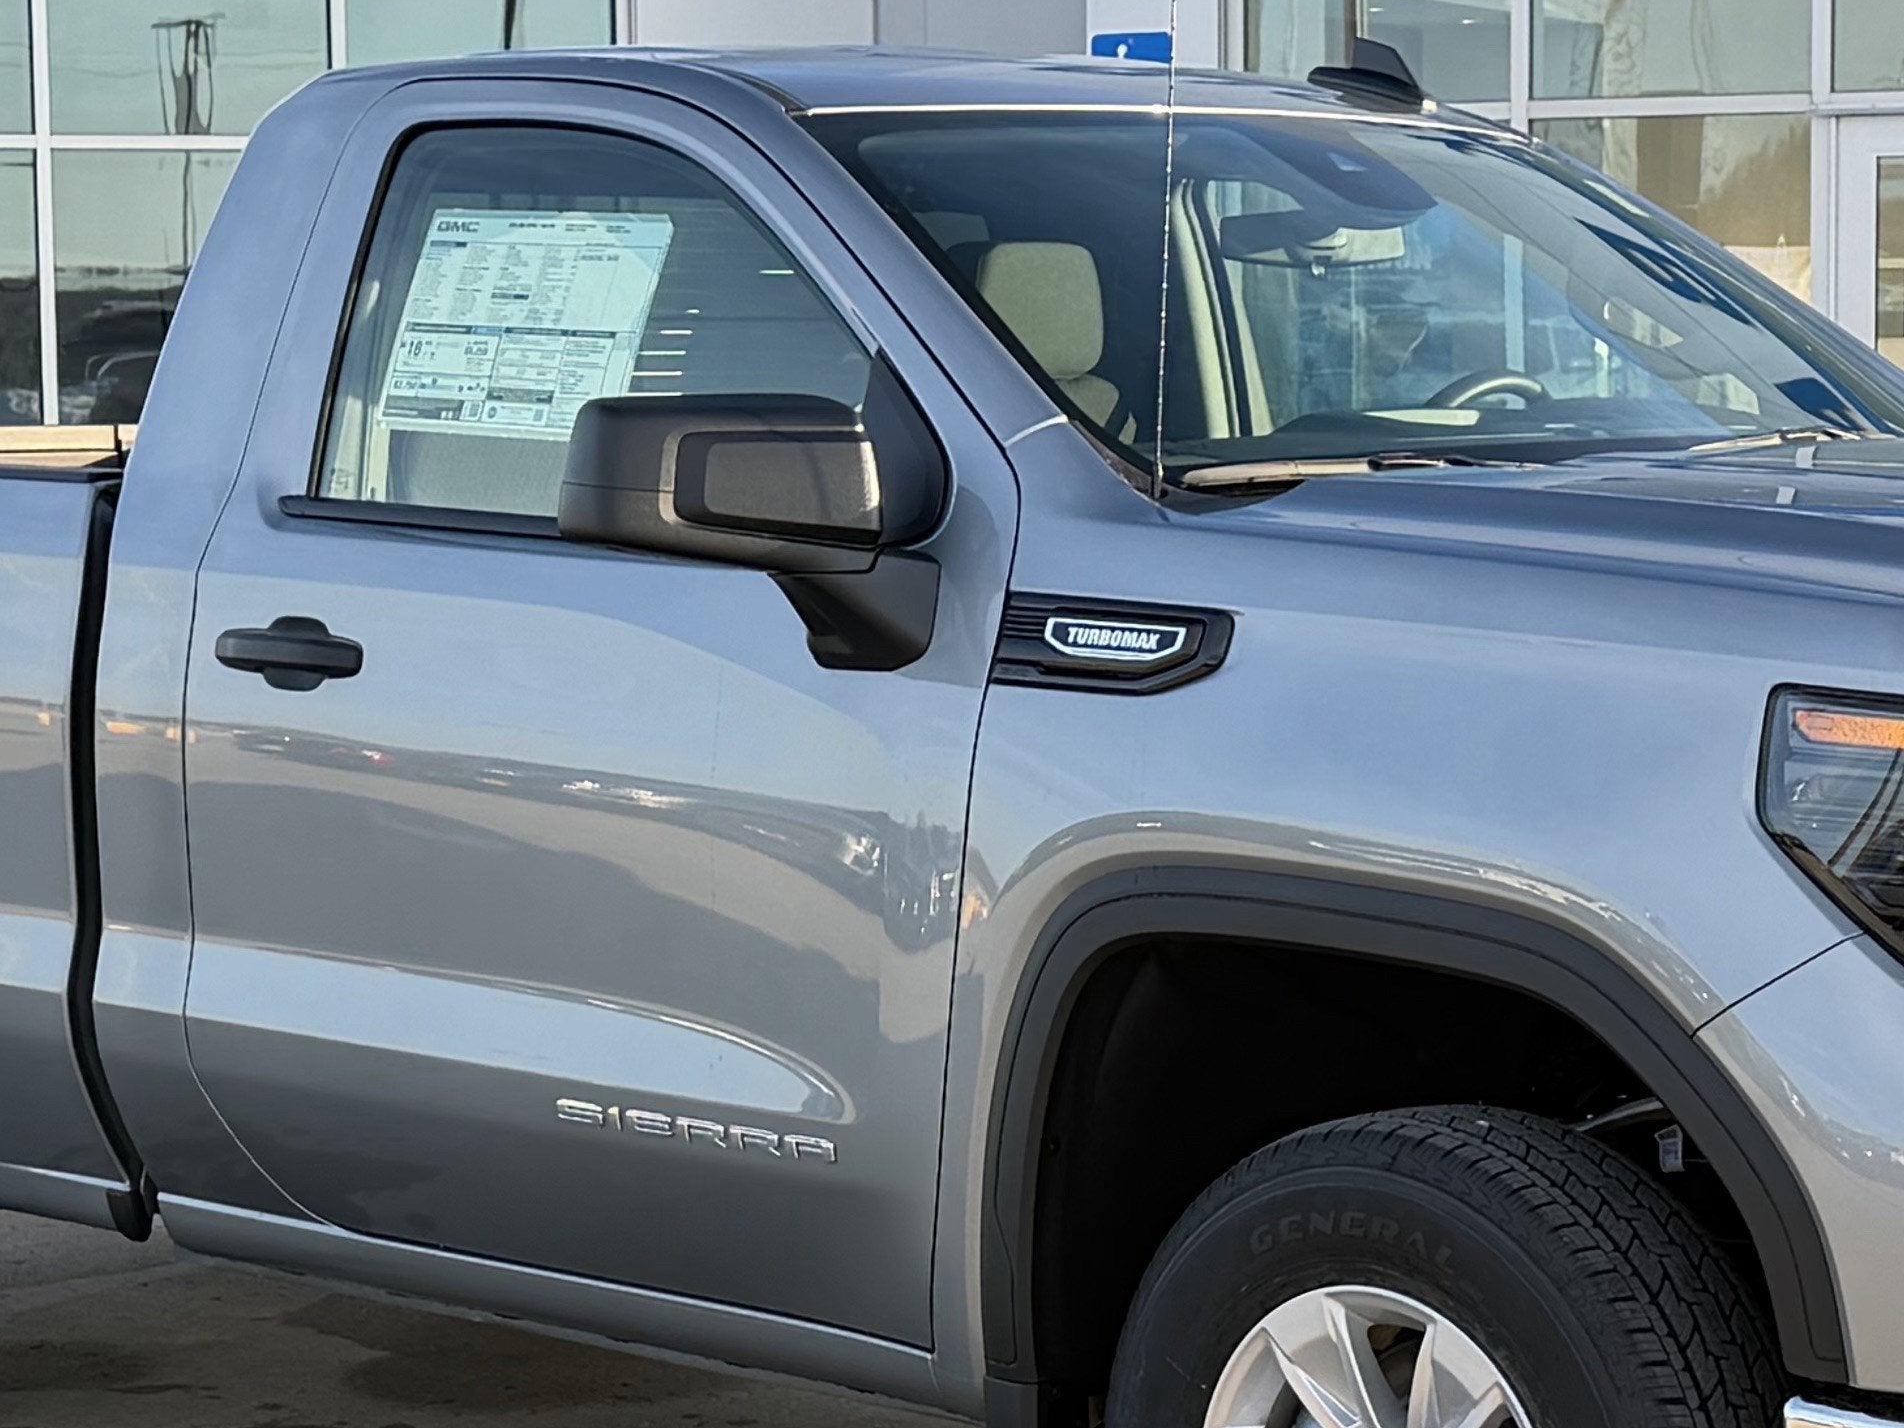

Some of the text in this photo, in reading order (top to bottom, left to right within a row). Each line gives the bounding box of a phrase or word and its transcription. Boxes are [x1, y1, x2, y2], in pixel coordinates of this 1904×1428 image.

[437, 220, 480, 234] GMC
[1067, 626, 1161, 651] TURBOMAX
[555, 1097, 840, 1165] SIERRA
[1249, 1209, 1455, 1275] GENERAL
